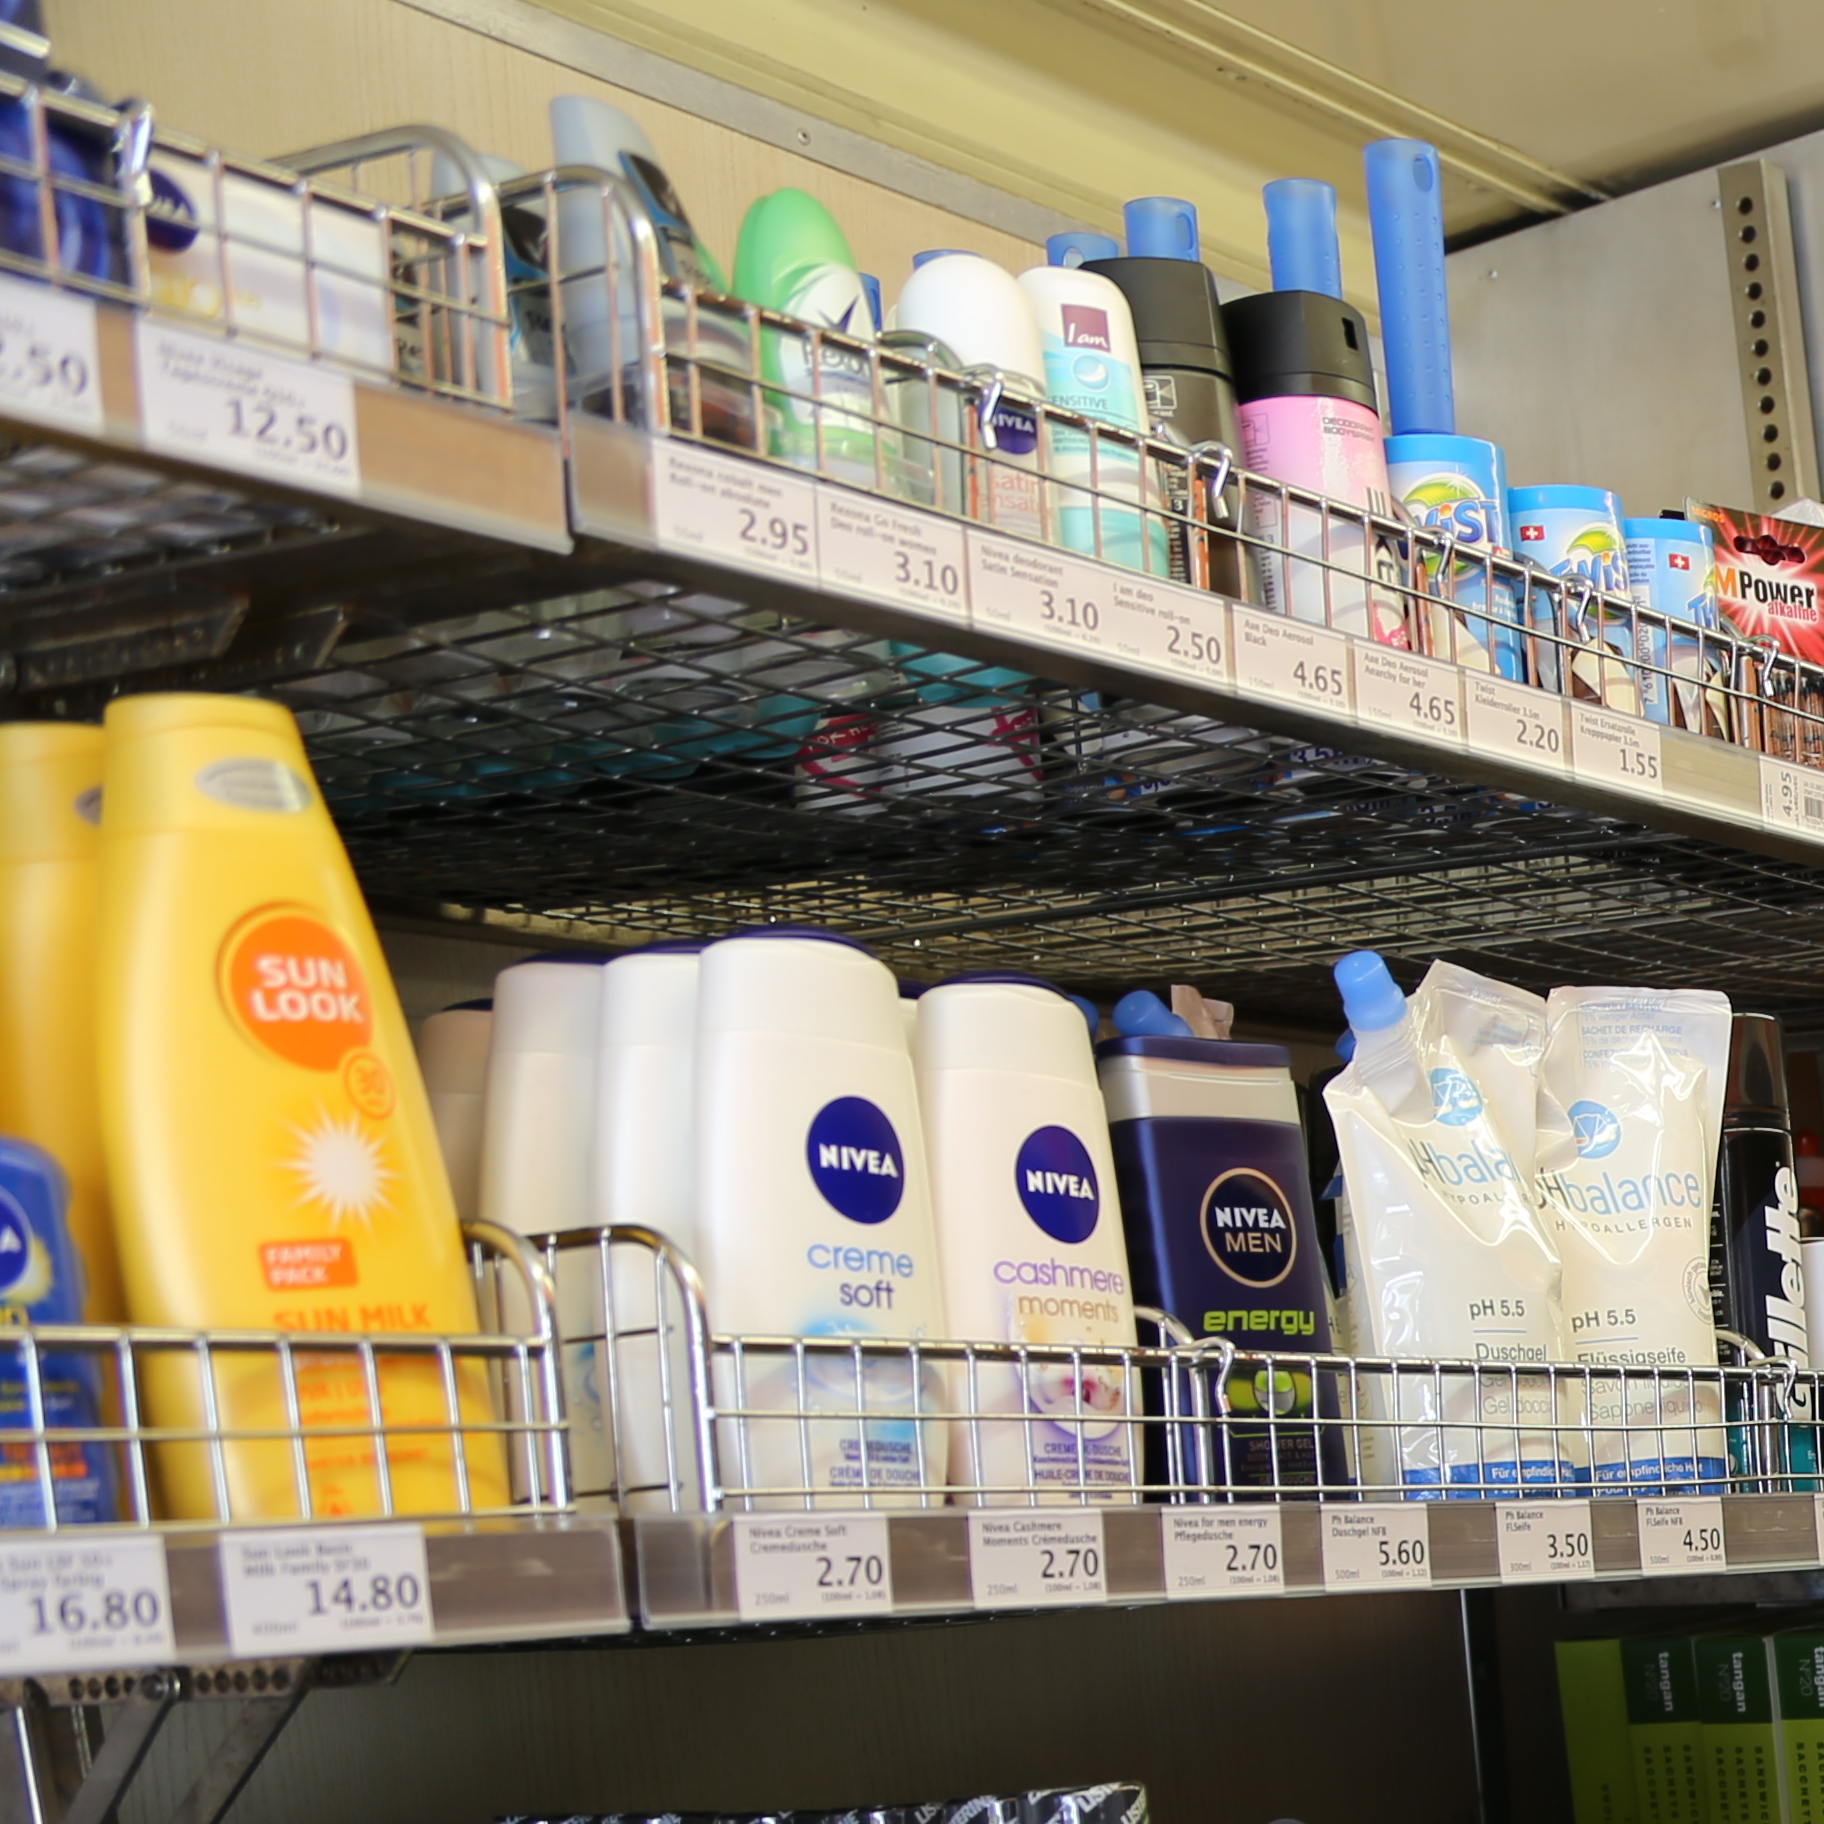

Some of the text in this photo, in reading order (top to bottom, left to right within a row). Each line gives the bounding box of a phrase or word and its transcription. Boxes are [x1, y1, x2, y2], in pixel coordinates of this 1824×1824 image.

[227, 399, 348, 460] 12.50
[738, 508, 809, 555] 2.95
[894, 550, 958, 596] 3.10
[1040, 590, 1099, 631] 3.10
[1768, 601, 1817, 622] alkaline
[1166, 625, 1221, 665] 2.50
[1293, 660, 1343, 696] 4.65
[1409, 691, 1455, 725] 4.65
[1516, 719, 1559, 753] 2.20
[1619, 749, 1658, 779] 1.55
[255, 954, 348, 990] SUN
[252, 989, 365, 1024] LOOK
[818, 1143, 899, 1178] NIVEA
[1025, 1169, 1095, 1201] NIVEA
[1214, 1205, 1287, 1230] NIVEA
[265, 1243, 343, 1267] FAMILY
[1224, 1231, 1282, 1254] MEN
[270, 1263, 329, 1285] PACK
[806, 1242, 914, 1278] creme
[993, 1257, 1125, 1295] cashmere
[838, 1278, 895, 1310] soft
[1017, 1294, 1119, 1324] moments
[1469, 1298, 1525, 1320] pH 5.5
[1202, 1309, 1316, 1337] energy
[1571, 1308, 1636, 1332] pH 5.5
[981, 1520, 1062, 1533] Nivea Cashmere
[1173, 1517, 1269, 1529] Nivea for men energy
[1174, 1529, 1234, 1542] Pflegedusche
[1378, 1539, 1425, 1566] 5.60
[1546, 1533, 1588, 1559] 3.50
[1682, 1528, 1721, 1551] 4.50
[815, 1554, 883, 1587] 2.70
[1039, 1548, 1099, 1578] 2.70
[1224, 1543, 1278, 1573] 2.70
[307, 1574, 420, 1616] 14.80
[30, 1588, 160, 1637] 16.80
[1658, 1652, 1674, 1713] tangan
[1732, 1652, 1747, 1713] tangan
